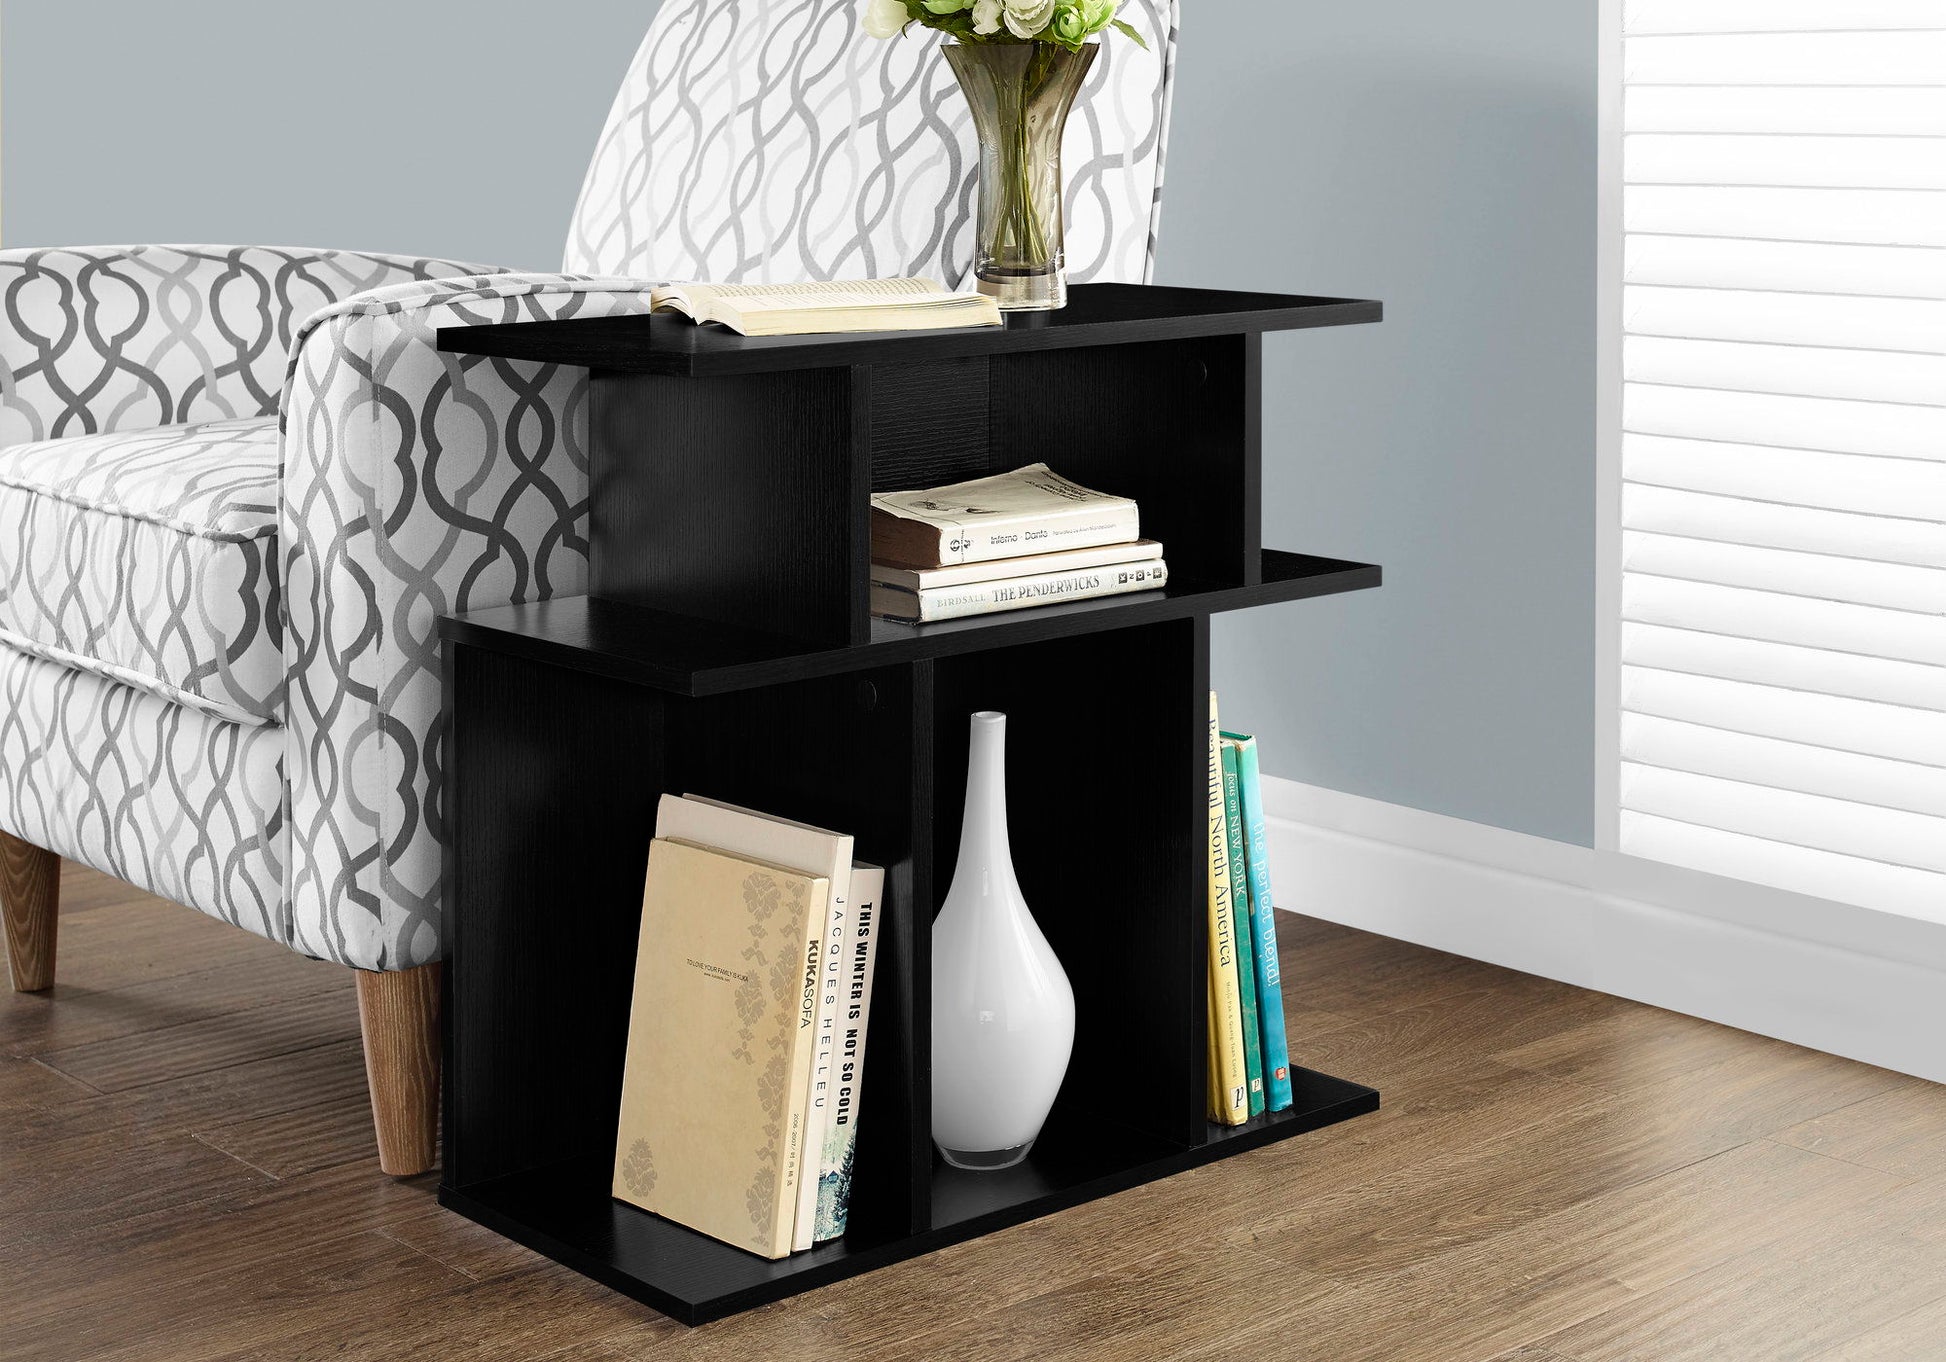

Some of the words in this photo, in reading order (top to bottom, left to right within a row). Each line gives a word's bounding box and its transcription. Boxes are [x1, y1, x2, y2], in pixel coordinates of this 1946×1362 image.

[990, 533, 1018, 545] Inferno
[1024, 529, 1049, 541] Dante
[936, 594, 986, 609] BIRDSALL
[992, 588, 1017, 603] THE
[1018, 574, 1101, 599] PENDERWICKS
[1226, 772, 1238, 797] focus
[1230, 799, 1238, 812] on
[1211, 814, 1228, 878] North
[1230, 815, 1241, 850] NEW
[1234, 853, 1246, 898] YORK
[857, 902, 873, 937] THIS
[1253, 822, 1265, 853] the
[1263, 927, 1281, 987] blend!
[1214, 884, 1231, 968] America
[825, 897, 845, 1005] JACQUES
[800, 939, 819, 1029] KUKASOFA
[850, 941, 869, 1000] WINTER
[848, 1004, 861, 1020] IS
[844, 1028, 858, 1058] NOT
[814, 1018, 832, 1108] HELLEU
[841, 1062, 854, 1083] SO
[836, 1086, 852, 1126] COLD
